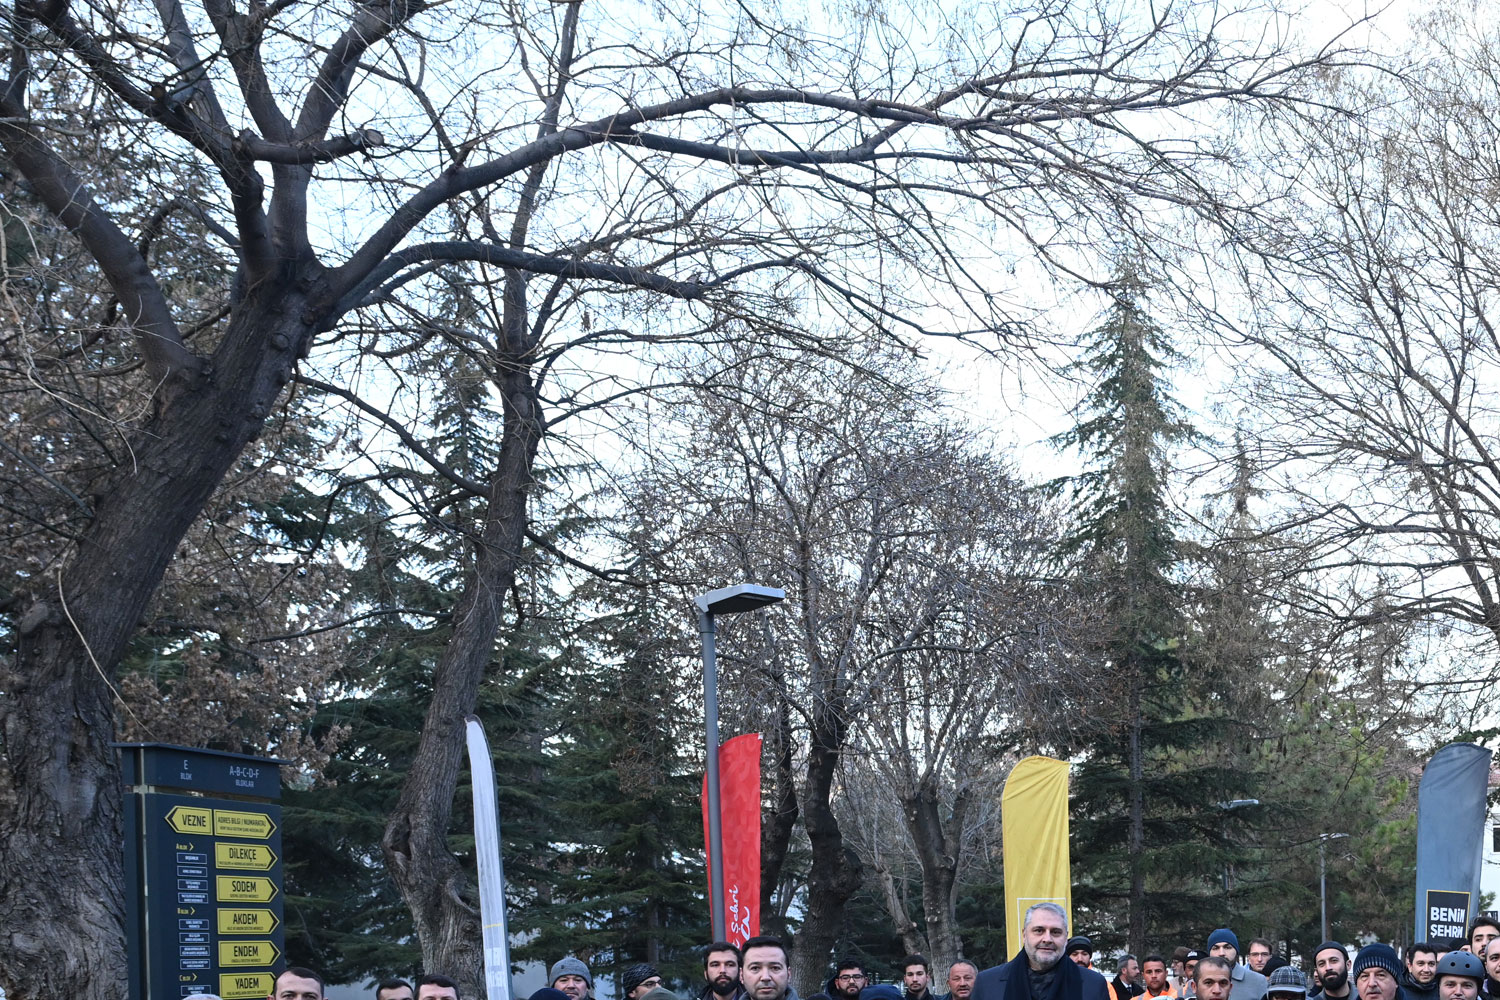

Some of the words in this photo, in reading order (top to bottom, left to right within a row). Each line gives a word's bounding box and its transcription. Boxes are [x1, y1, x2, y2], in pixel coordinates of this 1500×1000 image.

[183, 760, 189, 770] E
[181, 814, 207, 827] VEZNE
[229, 848, 256, 862] DİLEKÇE
[231, 880, 257, 892] SODEM
[233, 913, 258, 925] AKDEM
[233, 945, 259, 957] ENDEM
[235, 977, 259, 989] YADEM
